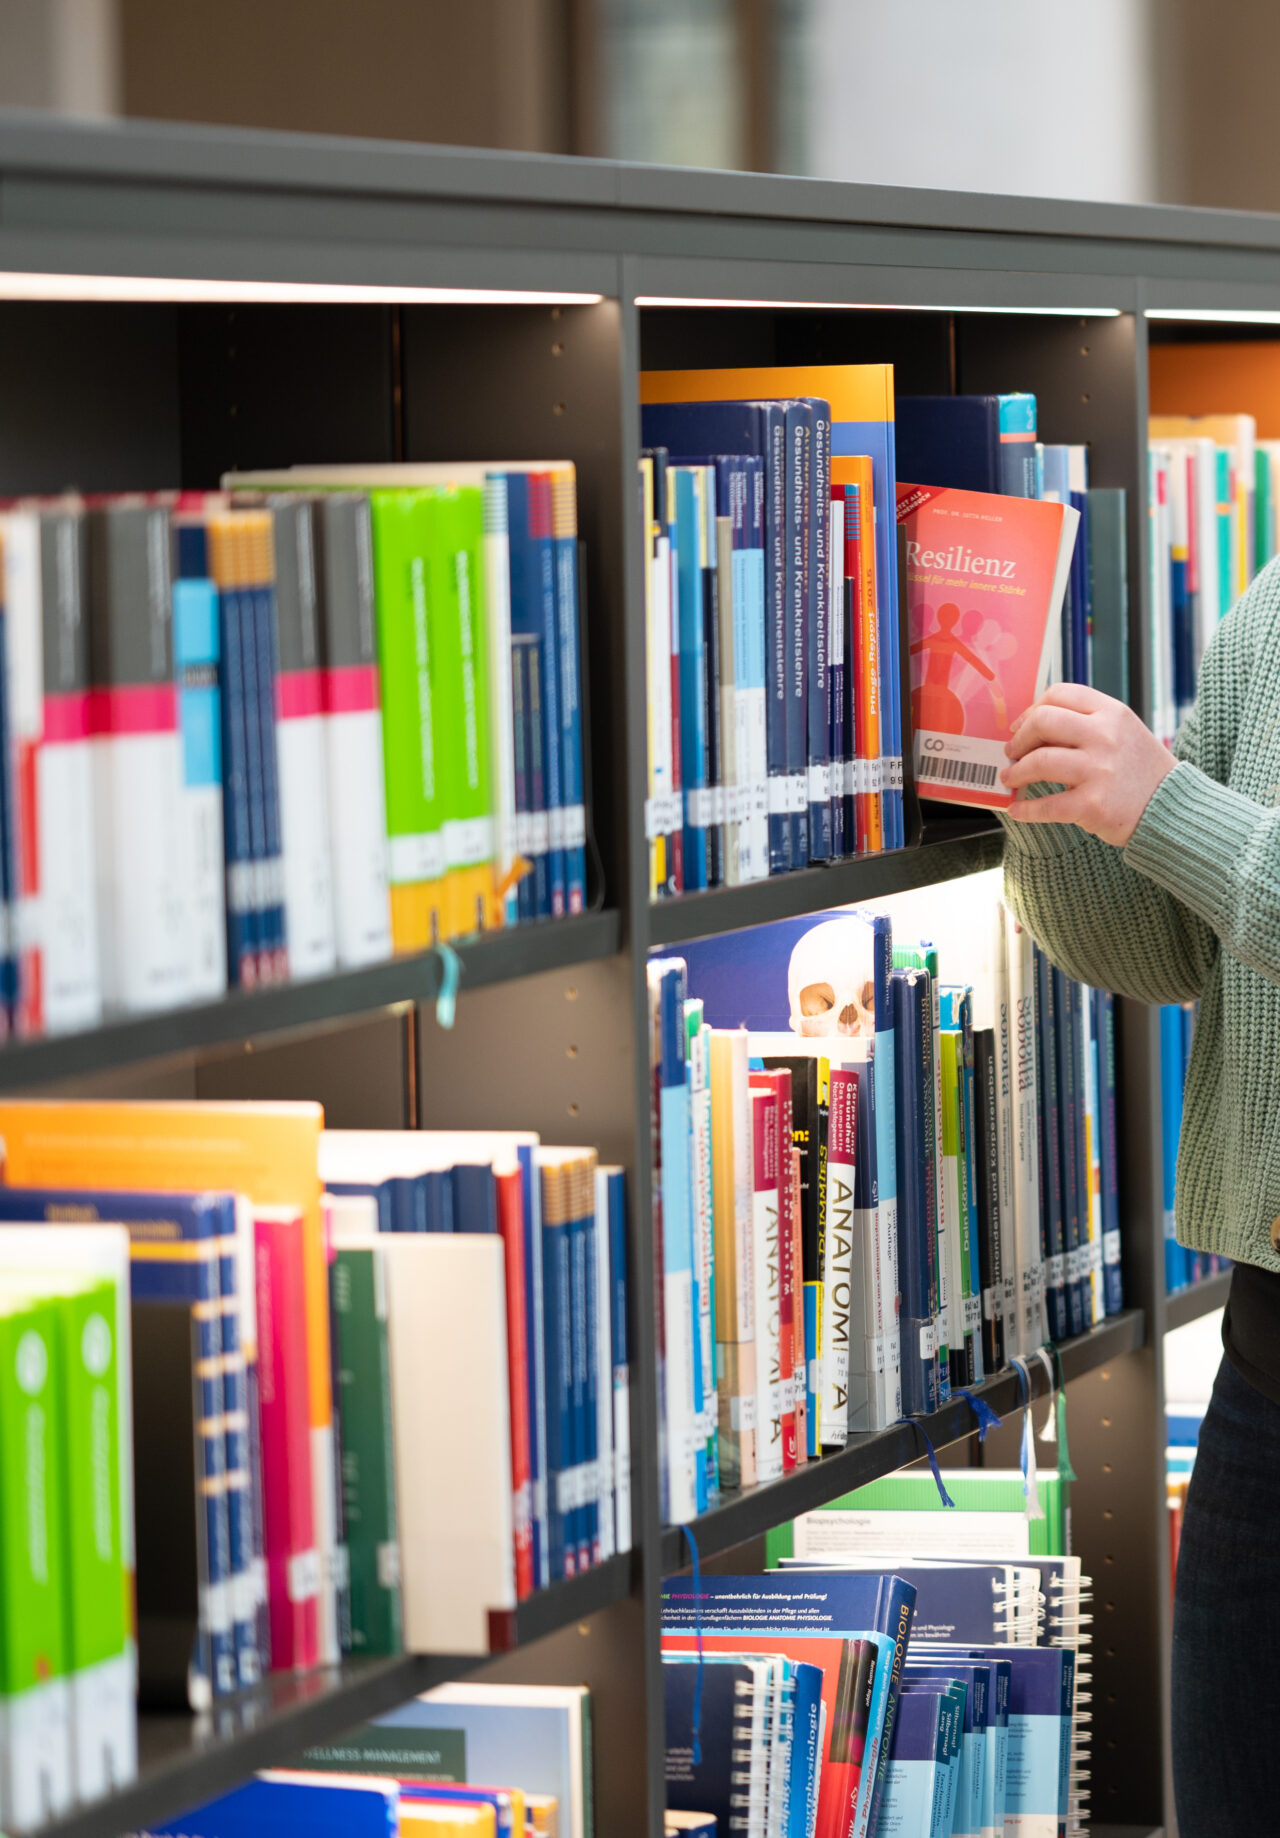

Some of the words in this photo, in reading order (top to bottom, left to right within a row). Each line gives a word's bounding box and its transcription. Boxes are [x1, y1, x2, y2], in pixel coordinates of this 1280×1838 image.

[773, 426, 783, 531] Gesundheits-
[794, 426, 804, 531] Gesundheits-
[816, 419, 825, 524] Gesundheits-
[774, 536, 783, 566] und
[794, 536, 803, 565] und
[816, 528, 825, 557] und
[905, 540, 1017, 579] Resilienz
[816, 563, 825, 689] Krankheitslehre
[931, 574, 945, 587] für
[945, 577, 969, 588] mehr
[968, 580, 997, 592] innere
[998, 583, 1027, 597] Stärke
[774, 571, 785, 700] Krankheitslehre
[794, 570, 803, 698] Krankheitslehre
[867, 612, 879, 716] Pflege-Report
[1001, 1003, 1010, 1098] Sobotta
[1017, 998, 1028, 1093] Sobotta
[1105, 1008, 1115, 1089] ANATOMIE
[831, 1081, 840, 1152] Nachschlagewerk
[845, 1083, 853, 1154] Gesundheit
[987, 1055, 998, 1167] Körpererleben
[1107, 1097, 1118, 1195] PHYSIOLOGIE
[818, 1144, 828, 1255] DUMMIES
[960, 1158, 968, 1213] Körper
[990, 1171, 999, 1202] und
[962, 1215, 970, 1252] Dein
[991, 1206, 1000, 1284] erhandeln
[831, 1178, 857, 1410] ANATOMIA
[752, 1593, 761, 1601] für
[761, 1593, 792, 1601] Ausbildung
[804, 1594, 828, 1602] Prüfung!
[927, 1624, 955, 1632] Physiologie
[892, 1603, 910, 1685] BIOLOGIE
[363, 1748, 442, 1764] MANAGEMENT
[861, 1737, 878, 1819] Physiologie
[875, 1691, 886, 1731] Lehrbuch
[878, 1692, 897, 1782] ANATOMIE
[939, 1710, 947, 1732] Lang
[943, 1711, 953, 1757] Silbernagl
[952, 1704, 960, 1749] Silbernagl
[804, 1702, 818, 1838] portphysiologie
